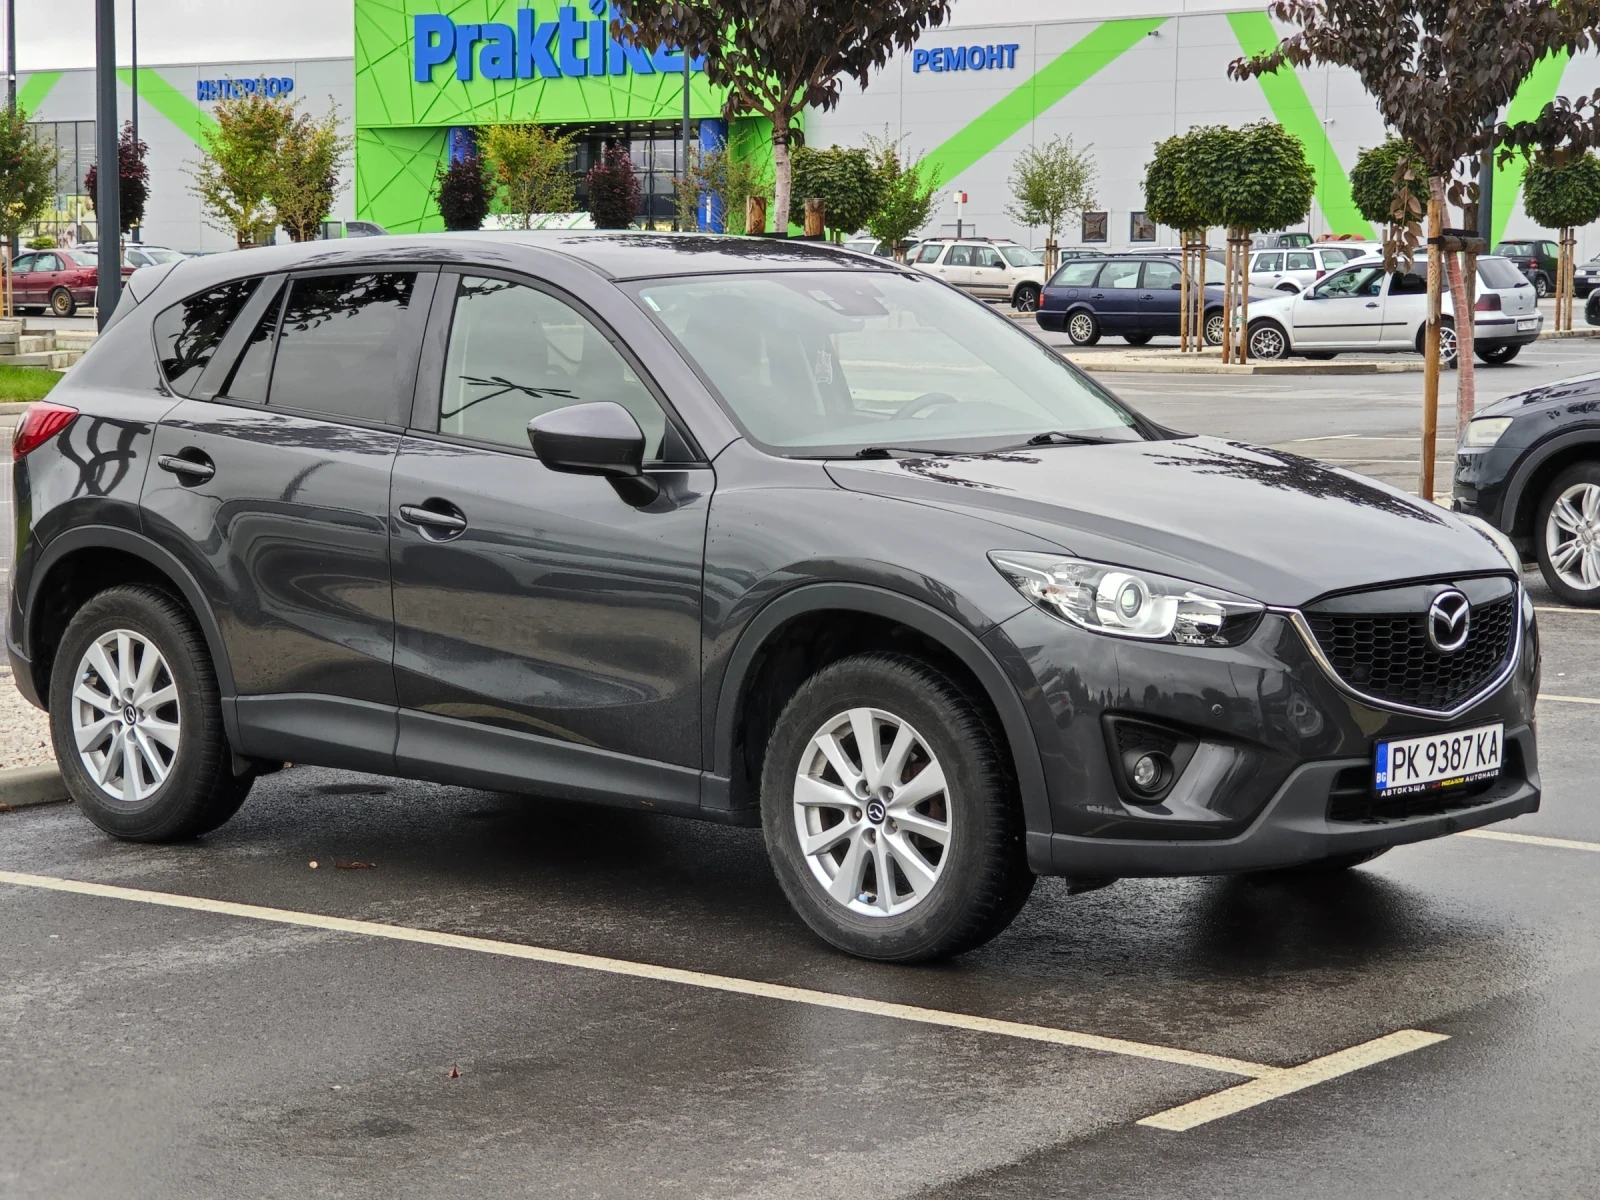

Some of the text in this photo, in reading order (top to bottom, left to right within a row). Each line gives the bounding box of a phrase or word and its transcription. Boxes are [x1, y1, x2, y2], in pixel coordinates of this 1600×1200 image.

[912, 44, 1019, 73] РЕМОНТ
[1426, 735, 1474, 776] 9387
[1376, 771, 1387, 784] BG
[1465, 770, 1499, 782] AUTOHAUS
[1381, 784, 1426, 797] АВТОКЪЩА
